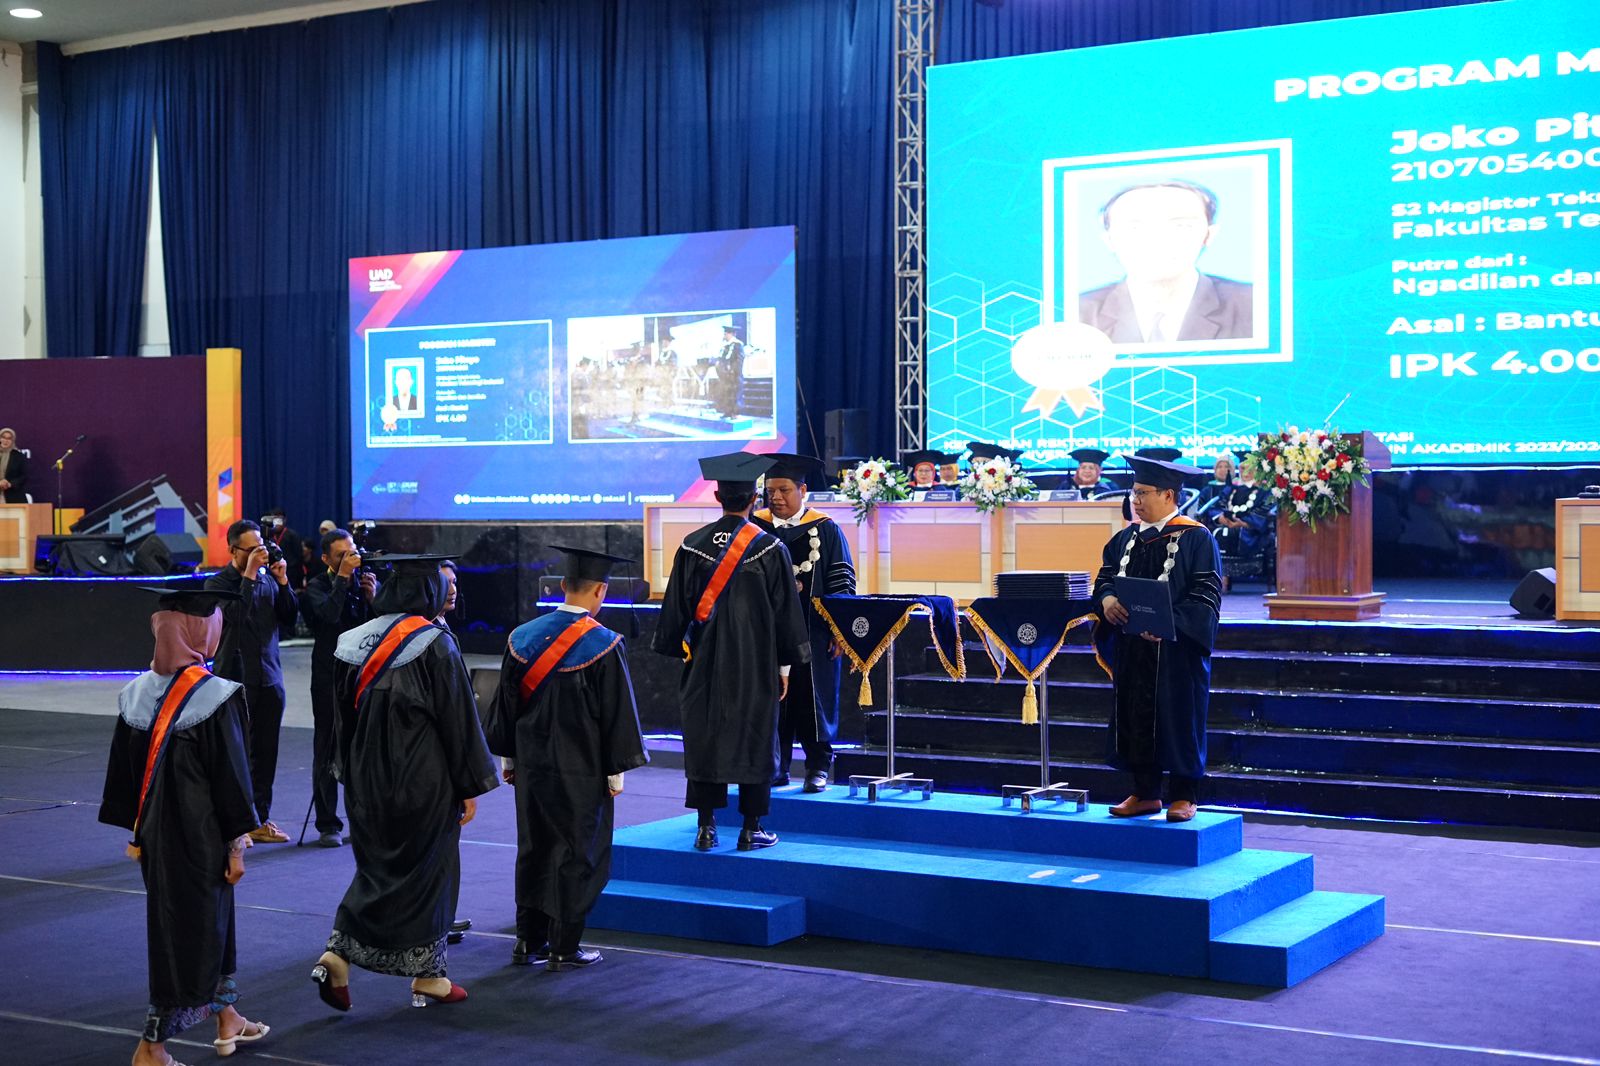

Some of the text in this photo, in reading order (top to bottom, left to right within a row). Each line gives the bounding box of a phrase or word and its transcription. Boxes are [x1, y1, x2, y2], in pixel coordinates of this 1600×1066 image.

[1274, 54, 1540, 102] PROGRAM
[1390, 124, 1520, 155] Joko
[1391, 147, 1600, 182] 210705400
[1391, 202, 1421, 216] S2
[1427, 196, 1541, 215] Magister
[1393, 215, 1548, 239] Fakultas
[1391, 259, 1458, 273] Putra
[1550, 268, 1600, 287] da
[1386, 313, 1465, 335] Asal
[1389, 347, 1600, 379] IPK 4.00
[1411, 442, 1512, 454] AKADEMIK
[1514, 440, 1600, 453] 2023/202
